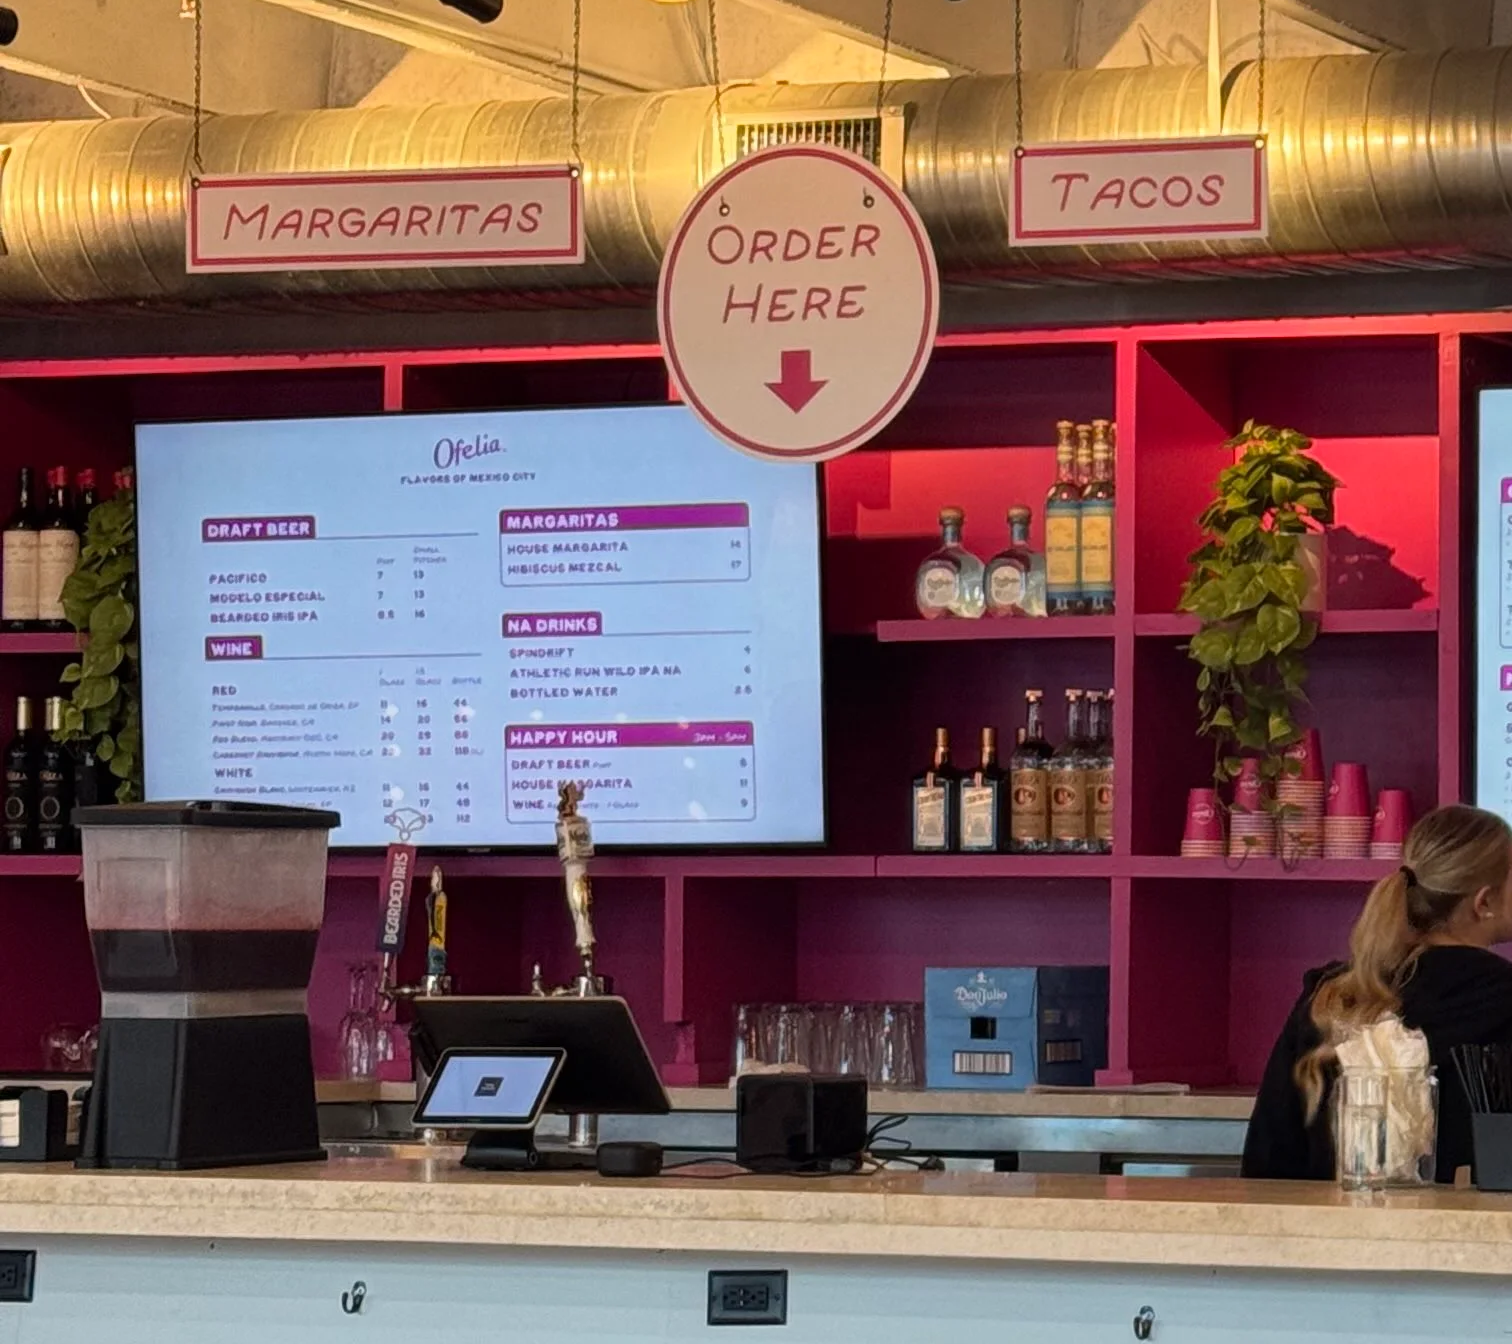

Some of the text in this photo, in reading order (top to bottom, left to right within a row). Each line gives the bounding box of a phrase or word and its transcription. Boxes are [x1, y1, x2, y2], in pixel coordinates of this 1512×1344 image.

[1051, 173, 1225, 212] TACOS
[223, 202, 543, 241] MARGARITAS
[707, 224, 881, 265] ORDER
[722, 283, 867, 324] HERE
[400, 472, 536, 485] FLAVORS OF MEXICO CITY
[507, 513, 619, 529] MARGARITAS
[207, 521, 310, 538] DRAFT BEER
[507, 544, 549, 555] HOUSE
[552, 541, 629, 553] MARGARITA
[508, 563, 565, 575] HIBISCUS
[568, 561, 622, 573] MEZCAL
[208, 573, 268, 585] PACIFICO
[209, 592, 262, 604] MODELO
[264, 590, 326, 603] ESPECIAL
[210, 611, 270, 624] BEARDED
[271, 610, 295, 622] IRIS
[297, 610, 319, 622] IPA
[507, 616, 598, 634] NA DRINKS
[211, 642, 253, 657] WINE
[509, 647, 575, 659] SPINDRIFT
[510, 666, 572, 679] ATHLETIC
[574, 666, 600, 677] RUN
[603, 665, 636, 677] WILD
[639, 665, 660, 676] IPA
[663, 664, 682, 676] NA
[212, 685, 238, 696] RED
[510, 686, 618, 699] BOTTLED WATER
[510, 731, 566, 745] HAPPY
[571, 729, 618, 744] HOUR
[511, 759, 553, 770] DRAFT
[557, 758, 591, 769] BEER
[214, 767, 253, 779] WHITE
[512, 779, 554, 790] HOUSE
[512, 800, 544, 810] WINE
[394, 851, 409, 881] IRIS
[383, 881, 405, 945] BEARDED
